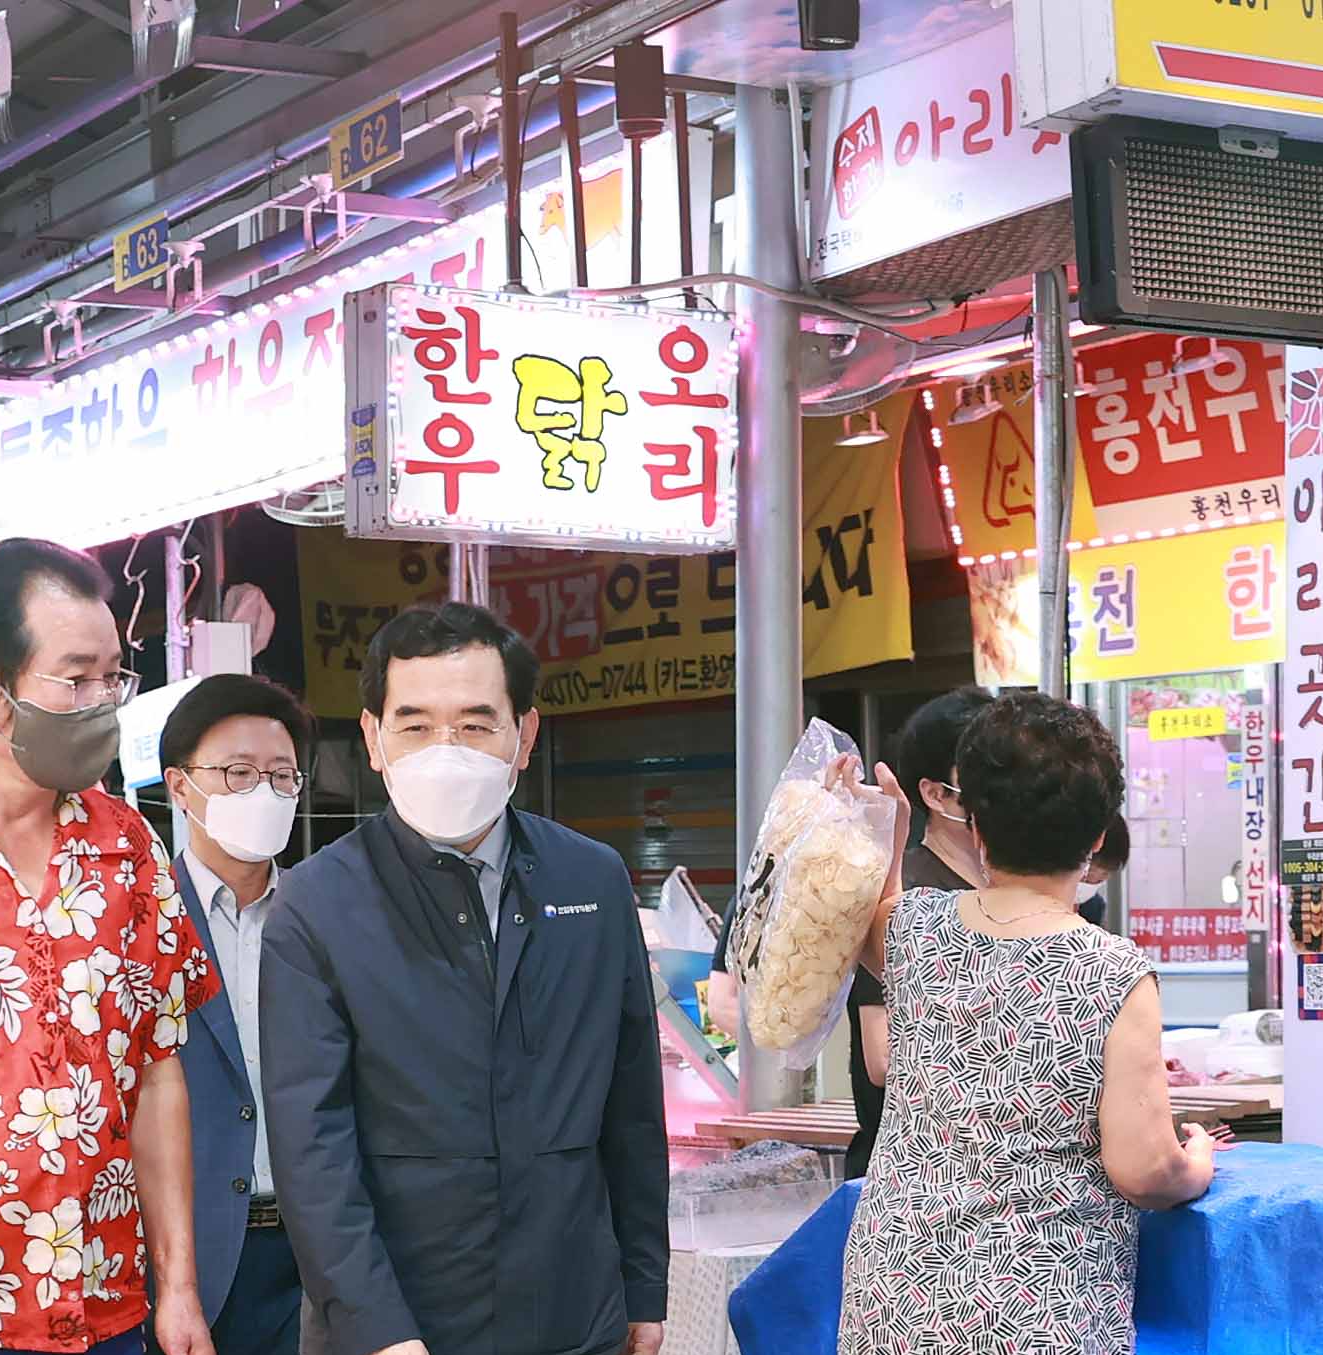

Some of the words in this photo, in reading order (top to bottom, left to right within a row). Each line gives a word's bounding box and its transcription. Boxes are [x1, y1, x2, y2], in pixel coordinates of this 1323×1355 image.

[360, 113, 389, 162] 62
[136, 227, 159, 270] 63
[402, 305, 500, 515] 한우
[512, 353, 628, 492] 닭
[638, 324, 730, 527] 오리
